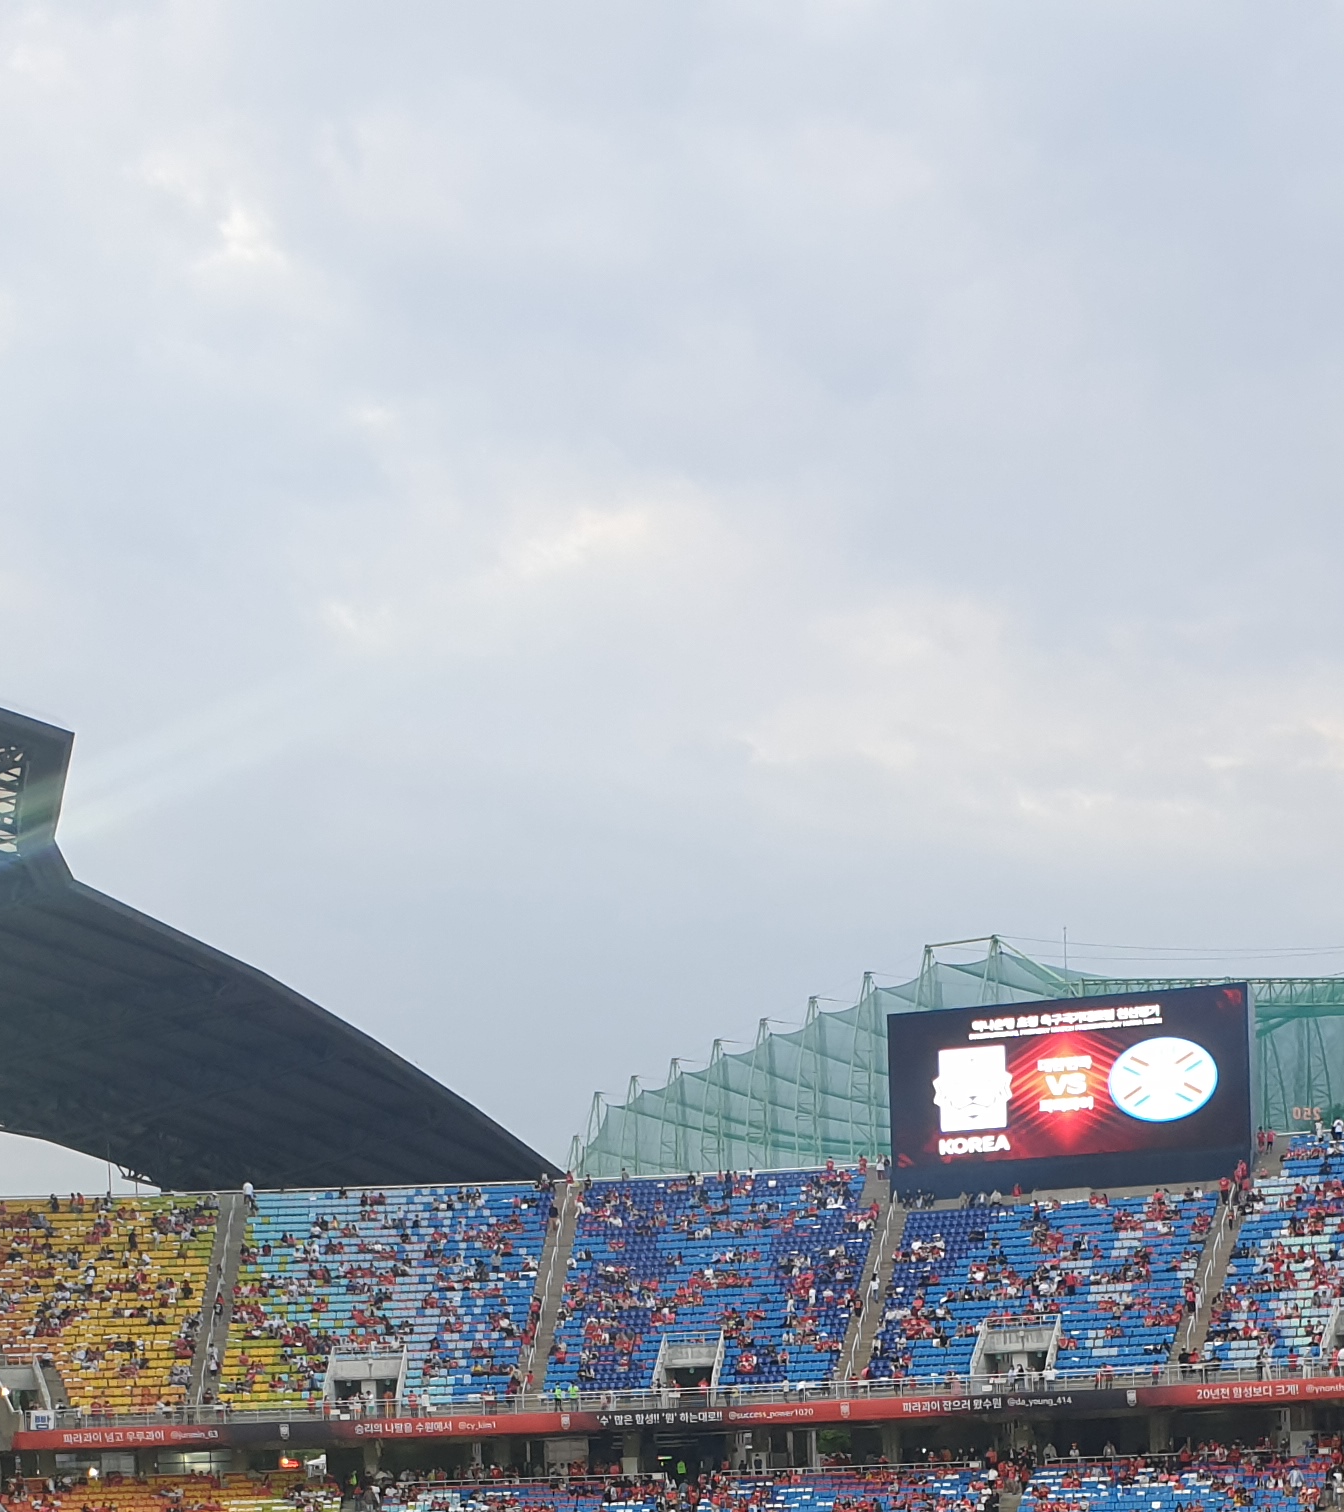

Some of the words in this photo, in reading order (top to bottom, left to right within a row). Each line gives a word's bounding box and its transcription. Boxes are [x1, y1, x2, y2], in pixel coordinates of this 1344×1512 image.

[1045, 1072, 1087, 1096] VS
[939, 1134, 1010, 1155] KOREA
[1233, 1385, 1272, 1399] 함성보다
[1275, 1384, 1299, 1396] 크게!
[354, 1423, 382, 1434] 승리의
[415, 1421, 452, 1433] 수원에서
[63, 1432, 102, 1443] 파라과이
